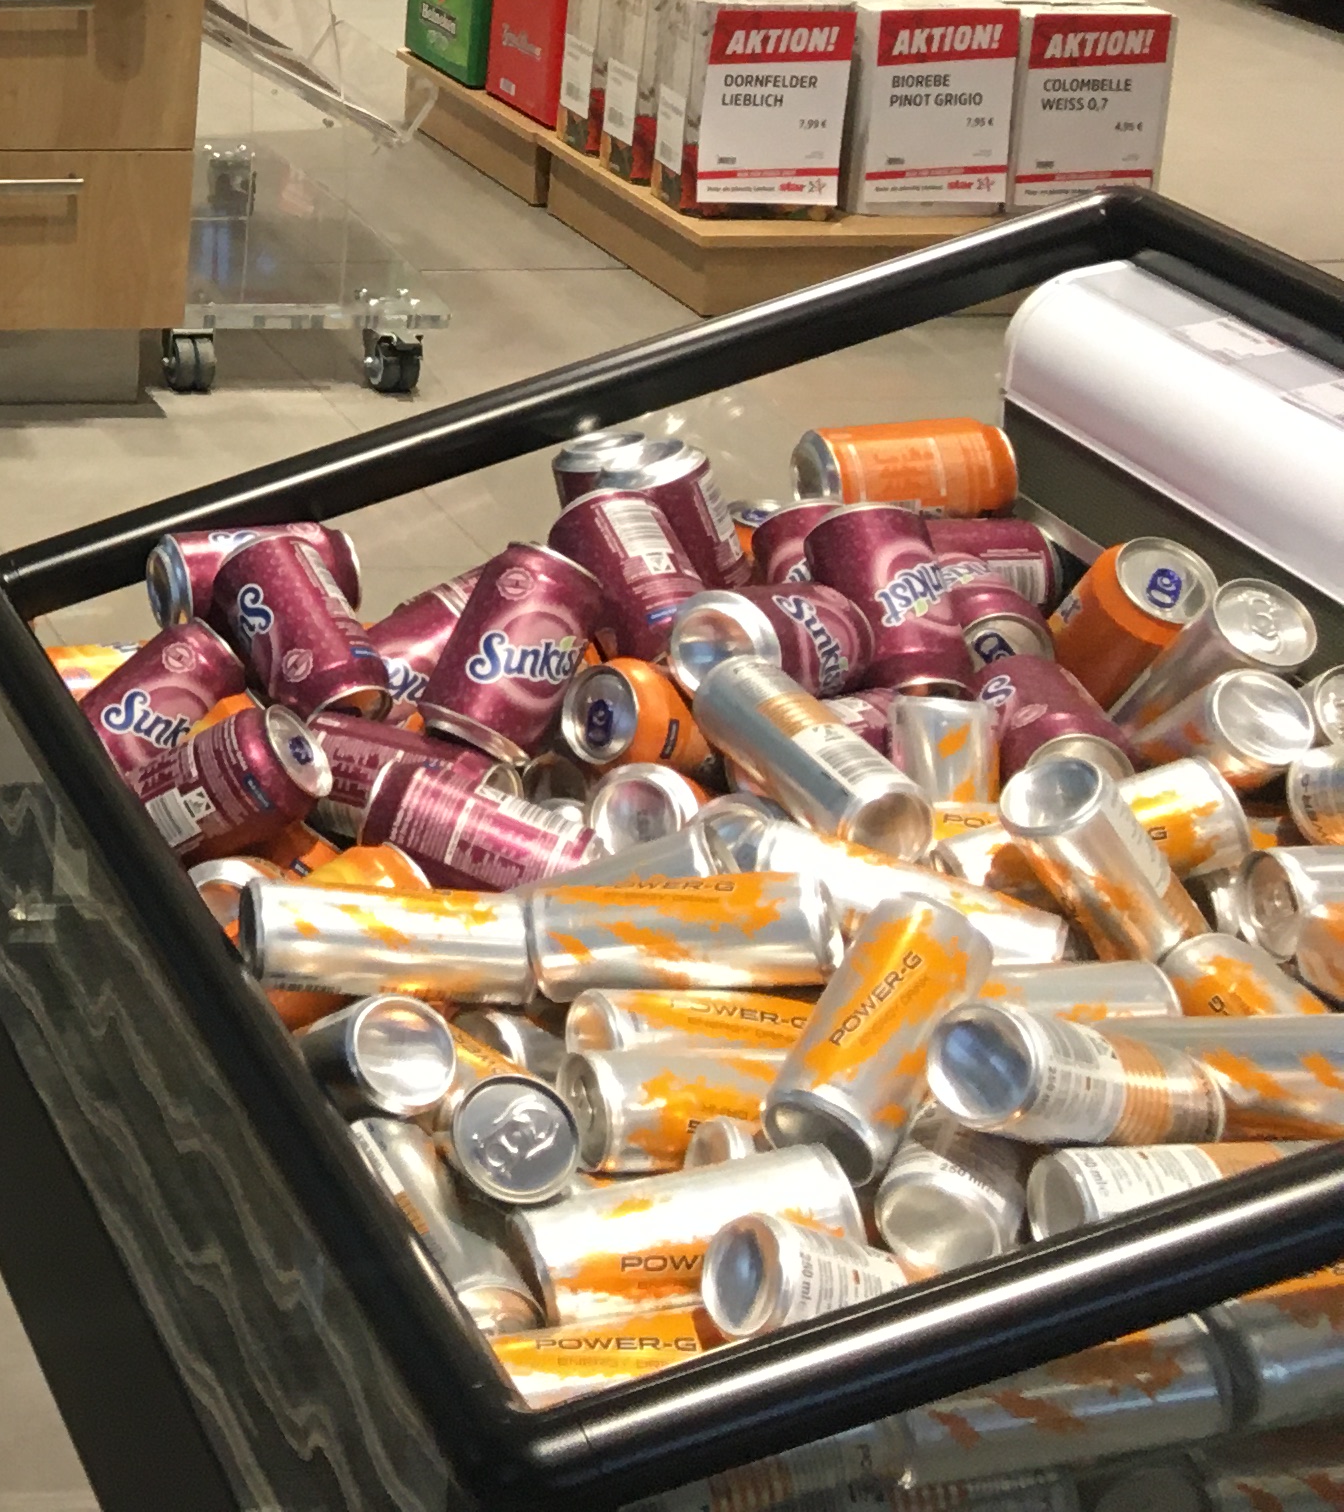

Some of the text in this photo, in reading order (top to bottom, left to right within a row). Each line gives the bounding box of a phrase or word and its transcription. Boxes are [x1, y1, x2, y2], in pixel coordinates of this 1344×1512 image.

[725, 26, 841, 55] AKTION!
[892, 23, 1004, 56] AKTION!
[1043, 29, 1156, 59] AKTION!
[724, 74, 818, 89] DORNFELDER
[892, 74, 952, 88] BIOREBE
[1043, 78, 1133, 93] COLOMBELLE
[721, 93, 784, 108] LIEBLICH
[889, 92, 984, 107] PINOT GRIGIO
[1041, 97, 1109, 112] WEISS 0,7
[874, 561, 947, 627] nkist
[101, 689, 191, 750] Sunk
[829, 951, 923, 1046] POWER-G
[534, 1336, 698, 1352] POWER-G
